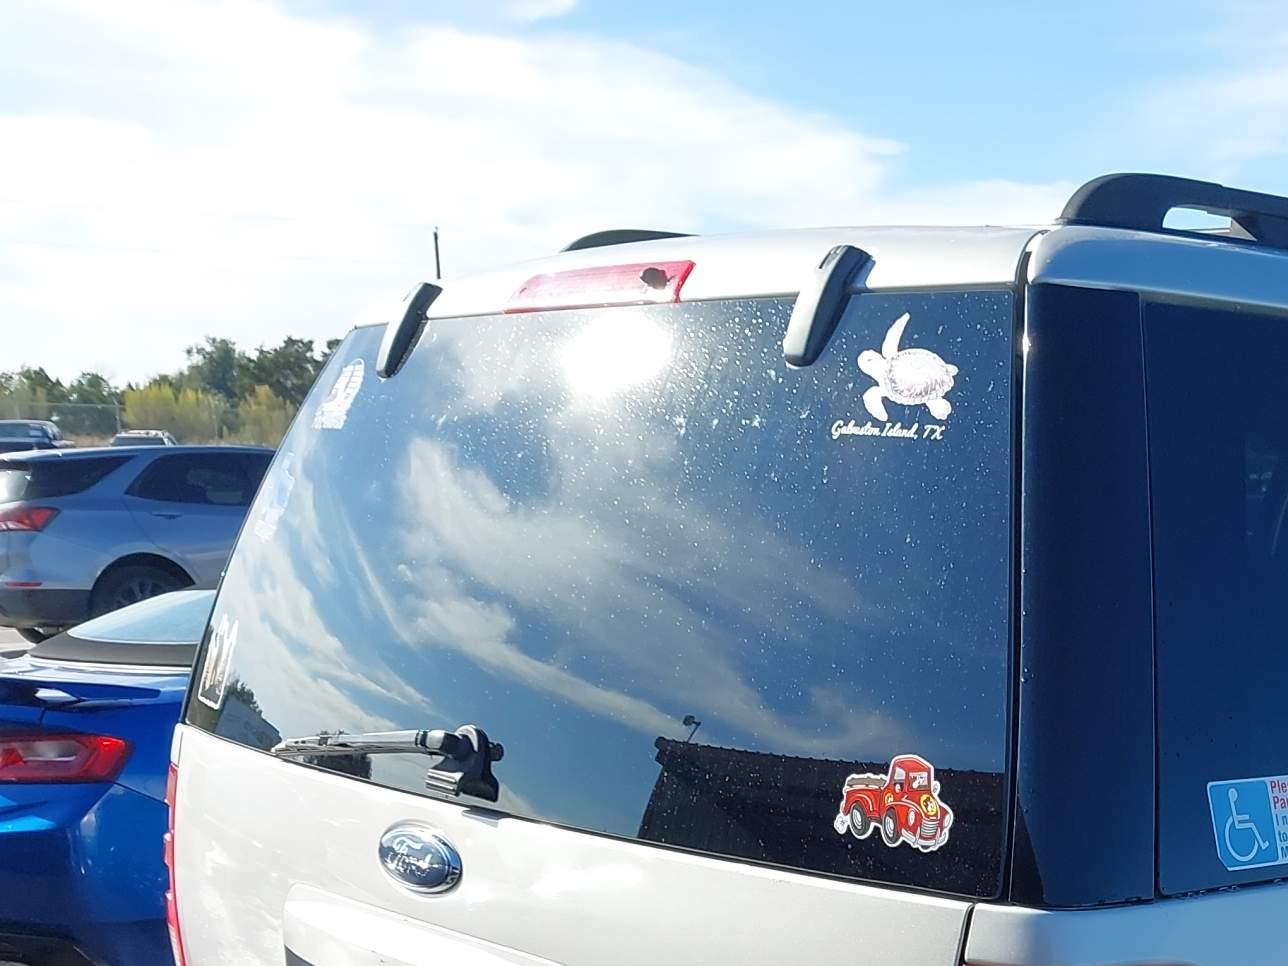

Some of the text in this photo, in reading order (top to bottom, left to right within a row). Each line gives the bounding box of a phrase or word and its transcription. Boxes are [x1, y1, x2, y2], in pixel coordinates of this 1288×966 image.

[881, 423, 919, 439] Island,
[922, 424, 946, 440] TX
[1278, 830, 1288, 842] to
[384, 837, 440, 876] Ford
